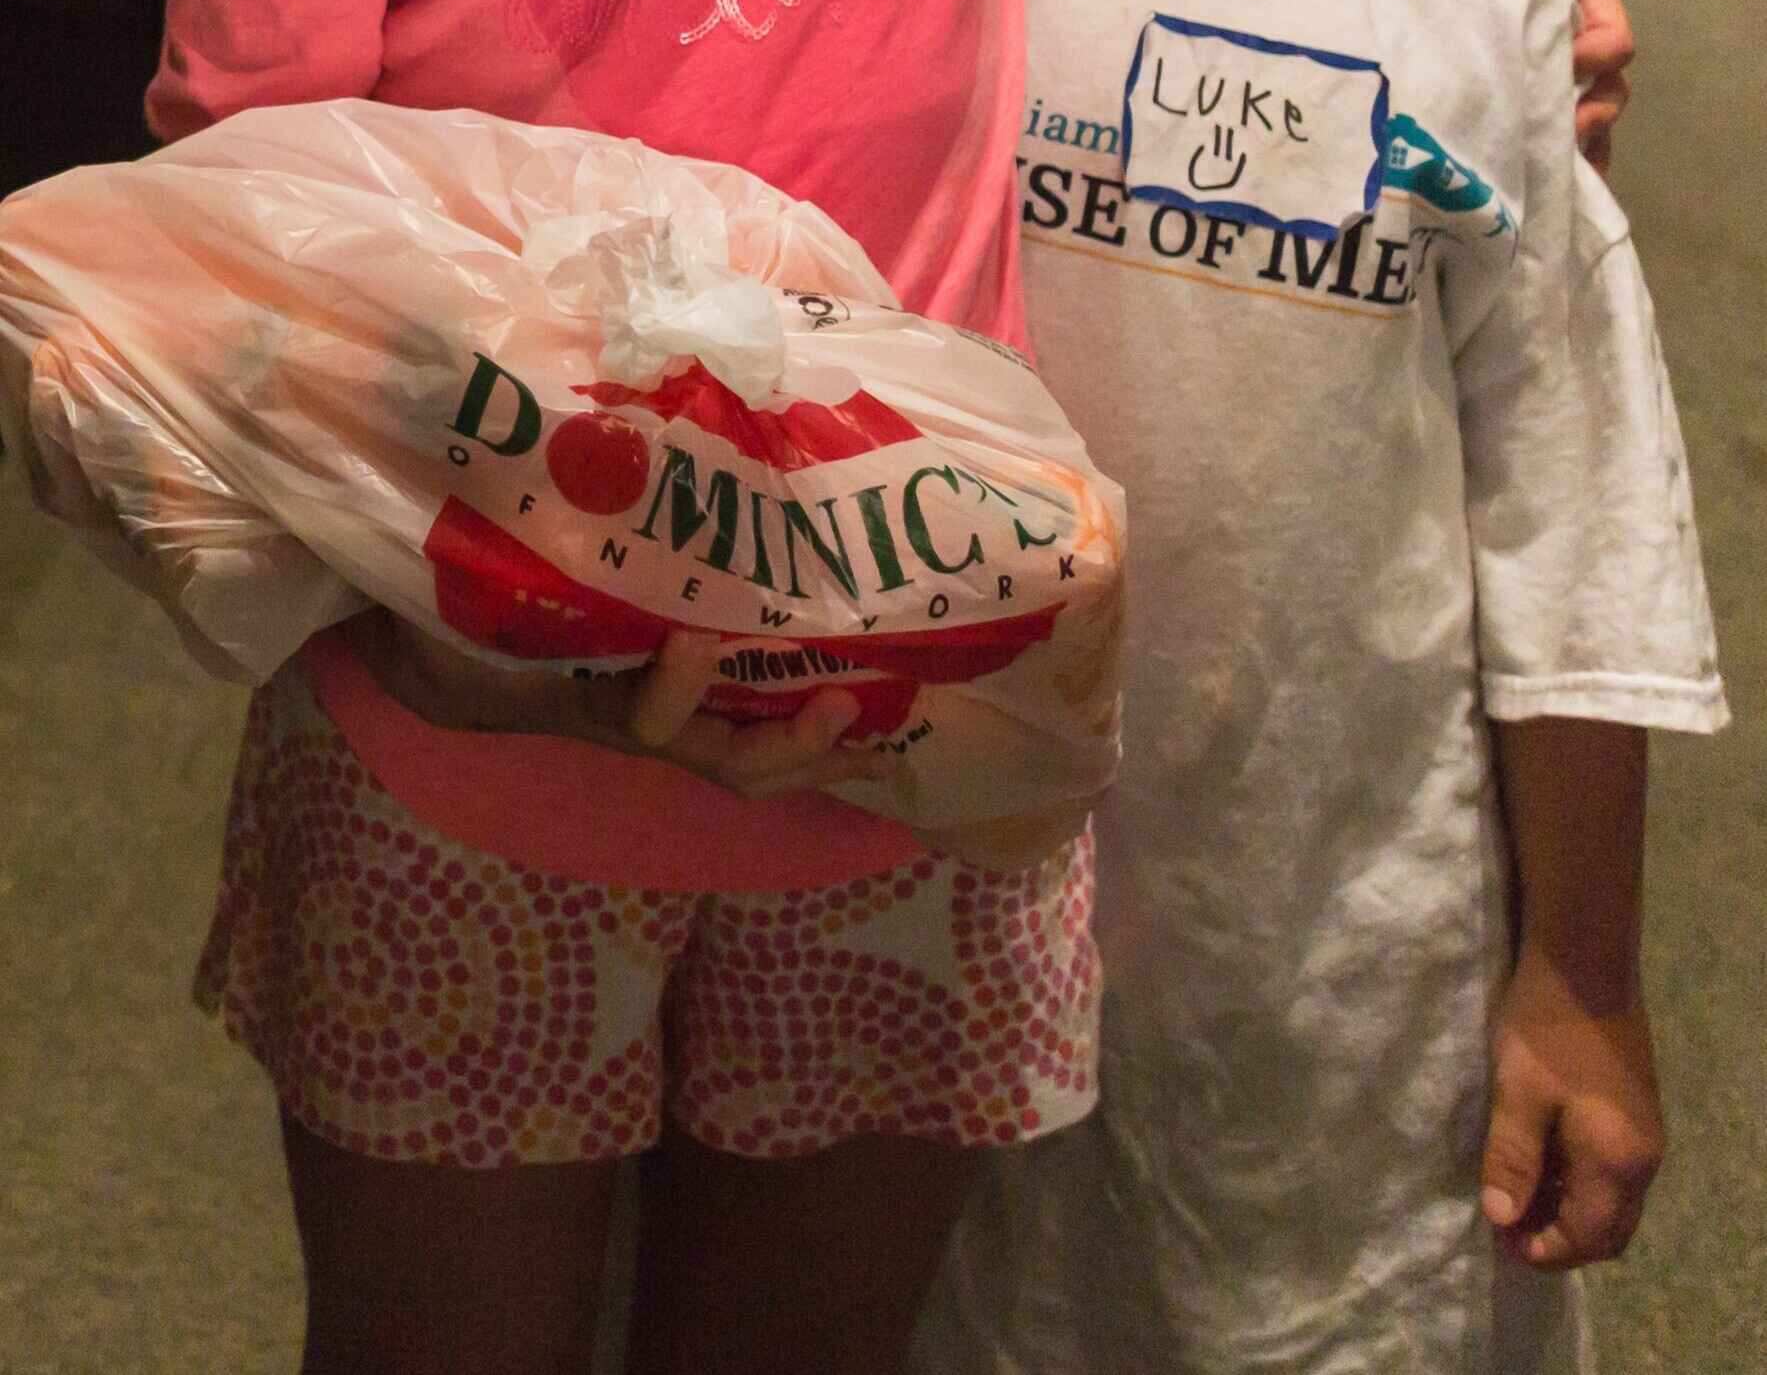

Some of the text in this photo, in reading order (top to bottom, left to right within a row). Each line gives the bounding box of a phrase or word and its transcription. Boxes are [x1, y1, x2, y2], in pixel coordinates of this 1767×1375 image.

[1016, 156, 1130, 248] SE
[1148, 204, 1247, 270] OF
[448, 444, 537, 515] OF
[600, 536, 793, 628] NEW
[862, 554, 1077, 632] YORK
